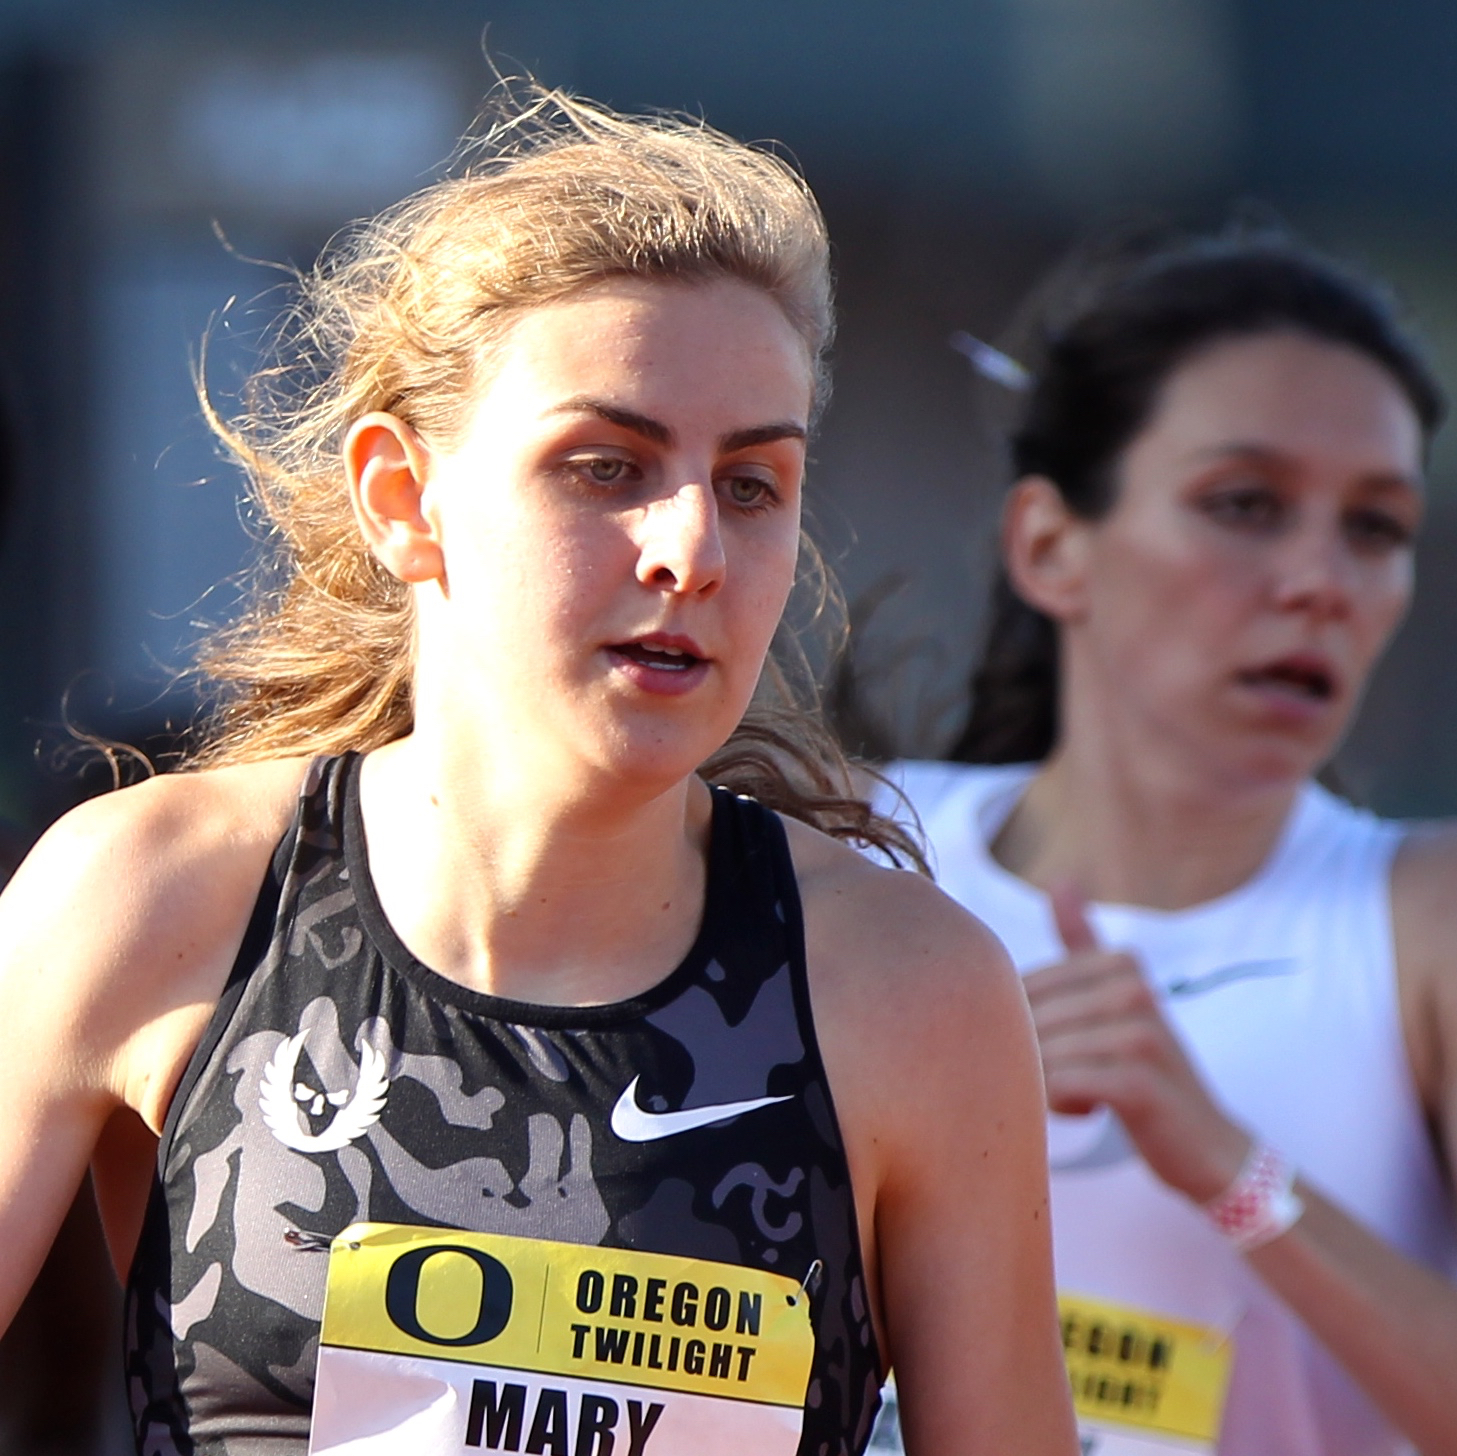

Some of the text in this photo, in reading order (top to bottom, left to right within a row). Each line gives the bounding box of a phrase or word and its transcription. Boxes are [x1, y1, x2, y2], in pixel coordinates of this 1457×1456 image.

[385, 1244, 513, 1347] O
[576, 1269, 762, 1337] OREGON
[570, 1324, 757, 1382] TWILIGHT
